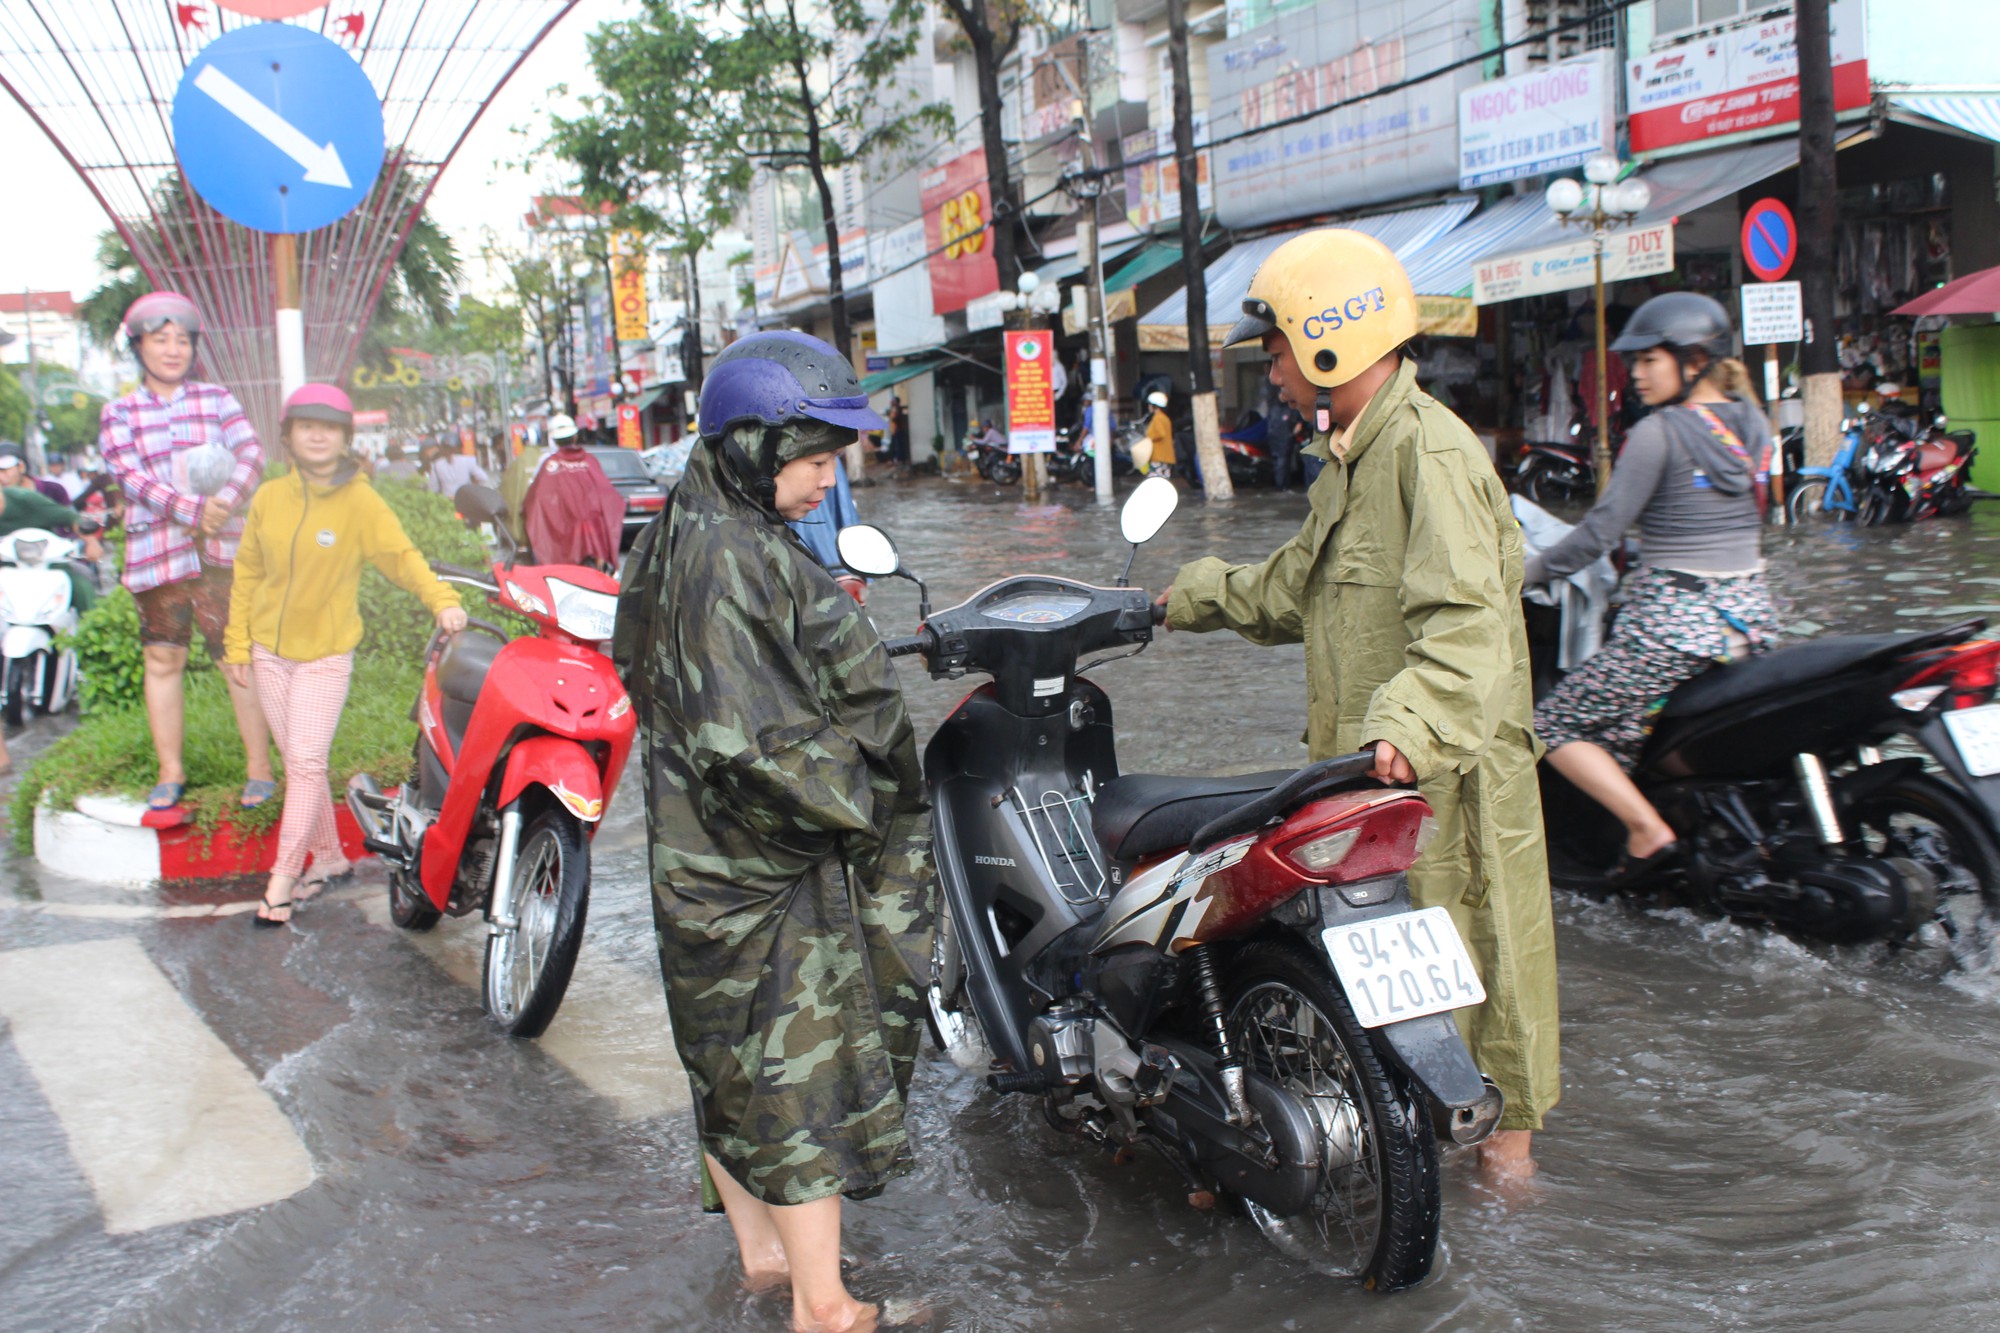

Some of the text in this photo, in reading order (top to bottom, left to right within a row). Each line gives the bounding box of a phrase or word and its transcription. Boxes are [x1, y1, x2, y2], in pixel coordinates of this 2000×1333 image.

[1470, 88, 1517, 124] NGỌC
[941, 190, 985, 260] 68
[1627, 229, 1665, 255] DUY
[1303, 287, 1385, 340] CSGT
[975, 855, 1017, 867] HONDA
[1355, 959, 1474, 1017] 120.64
